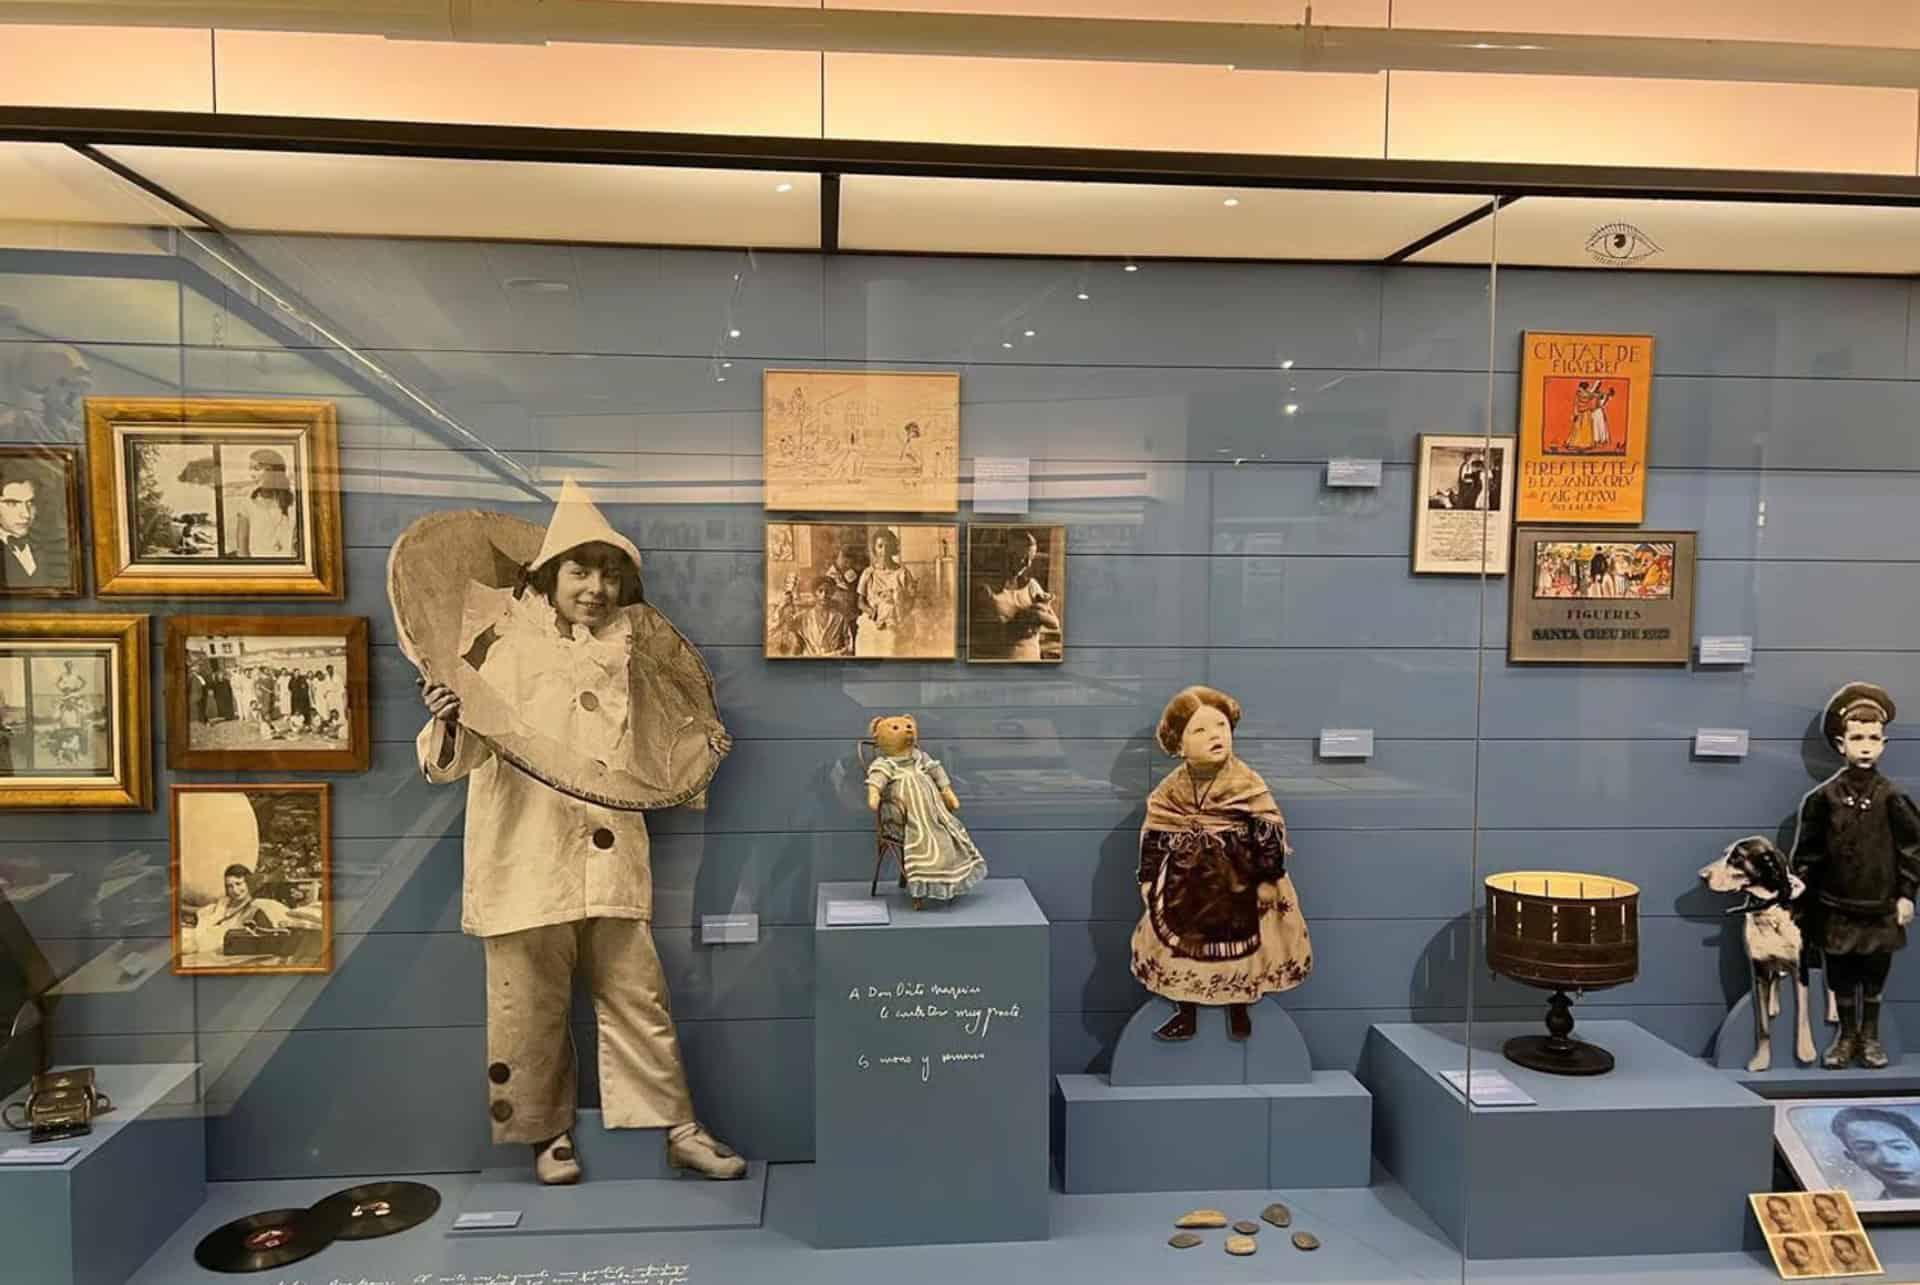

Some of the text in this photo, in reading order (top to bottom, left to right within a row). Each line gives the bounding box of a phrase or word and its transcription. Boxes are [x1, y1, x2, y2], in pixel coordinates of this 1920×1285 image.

[1616, 344, 1641, 362] DE
[1567, 609, 1641, 620] FIGUERES
[1532, 628, 1580, 640] SANTA
[848, 988, 861, 1000] A
